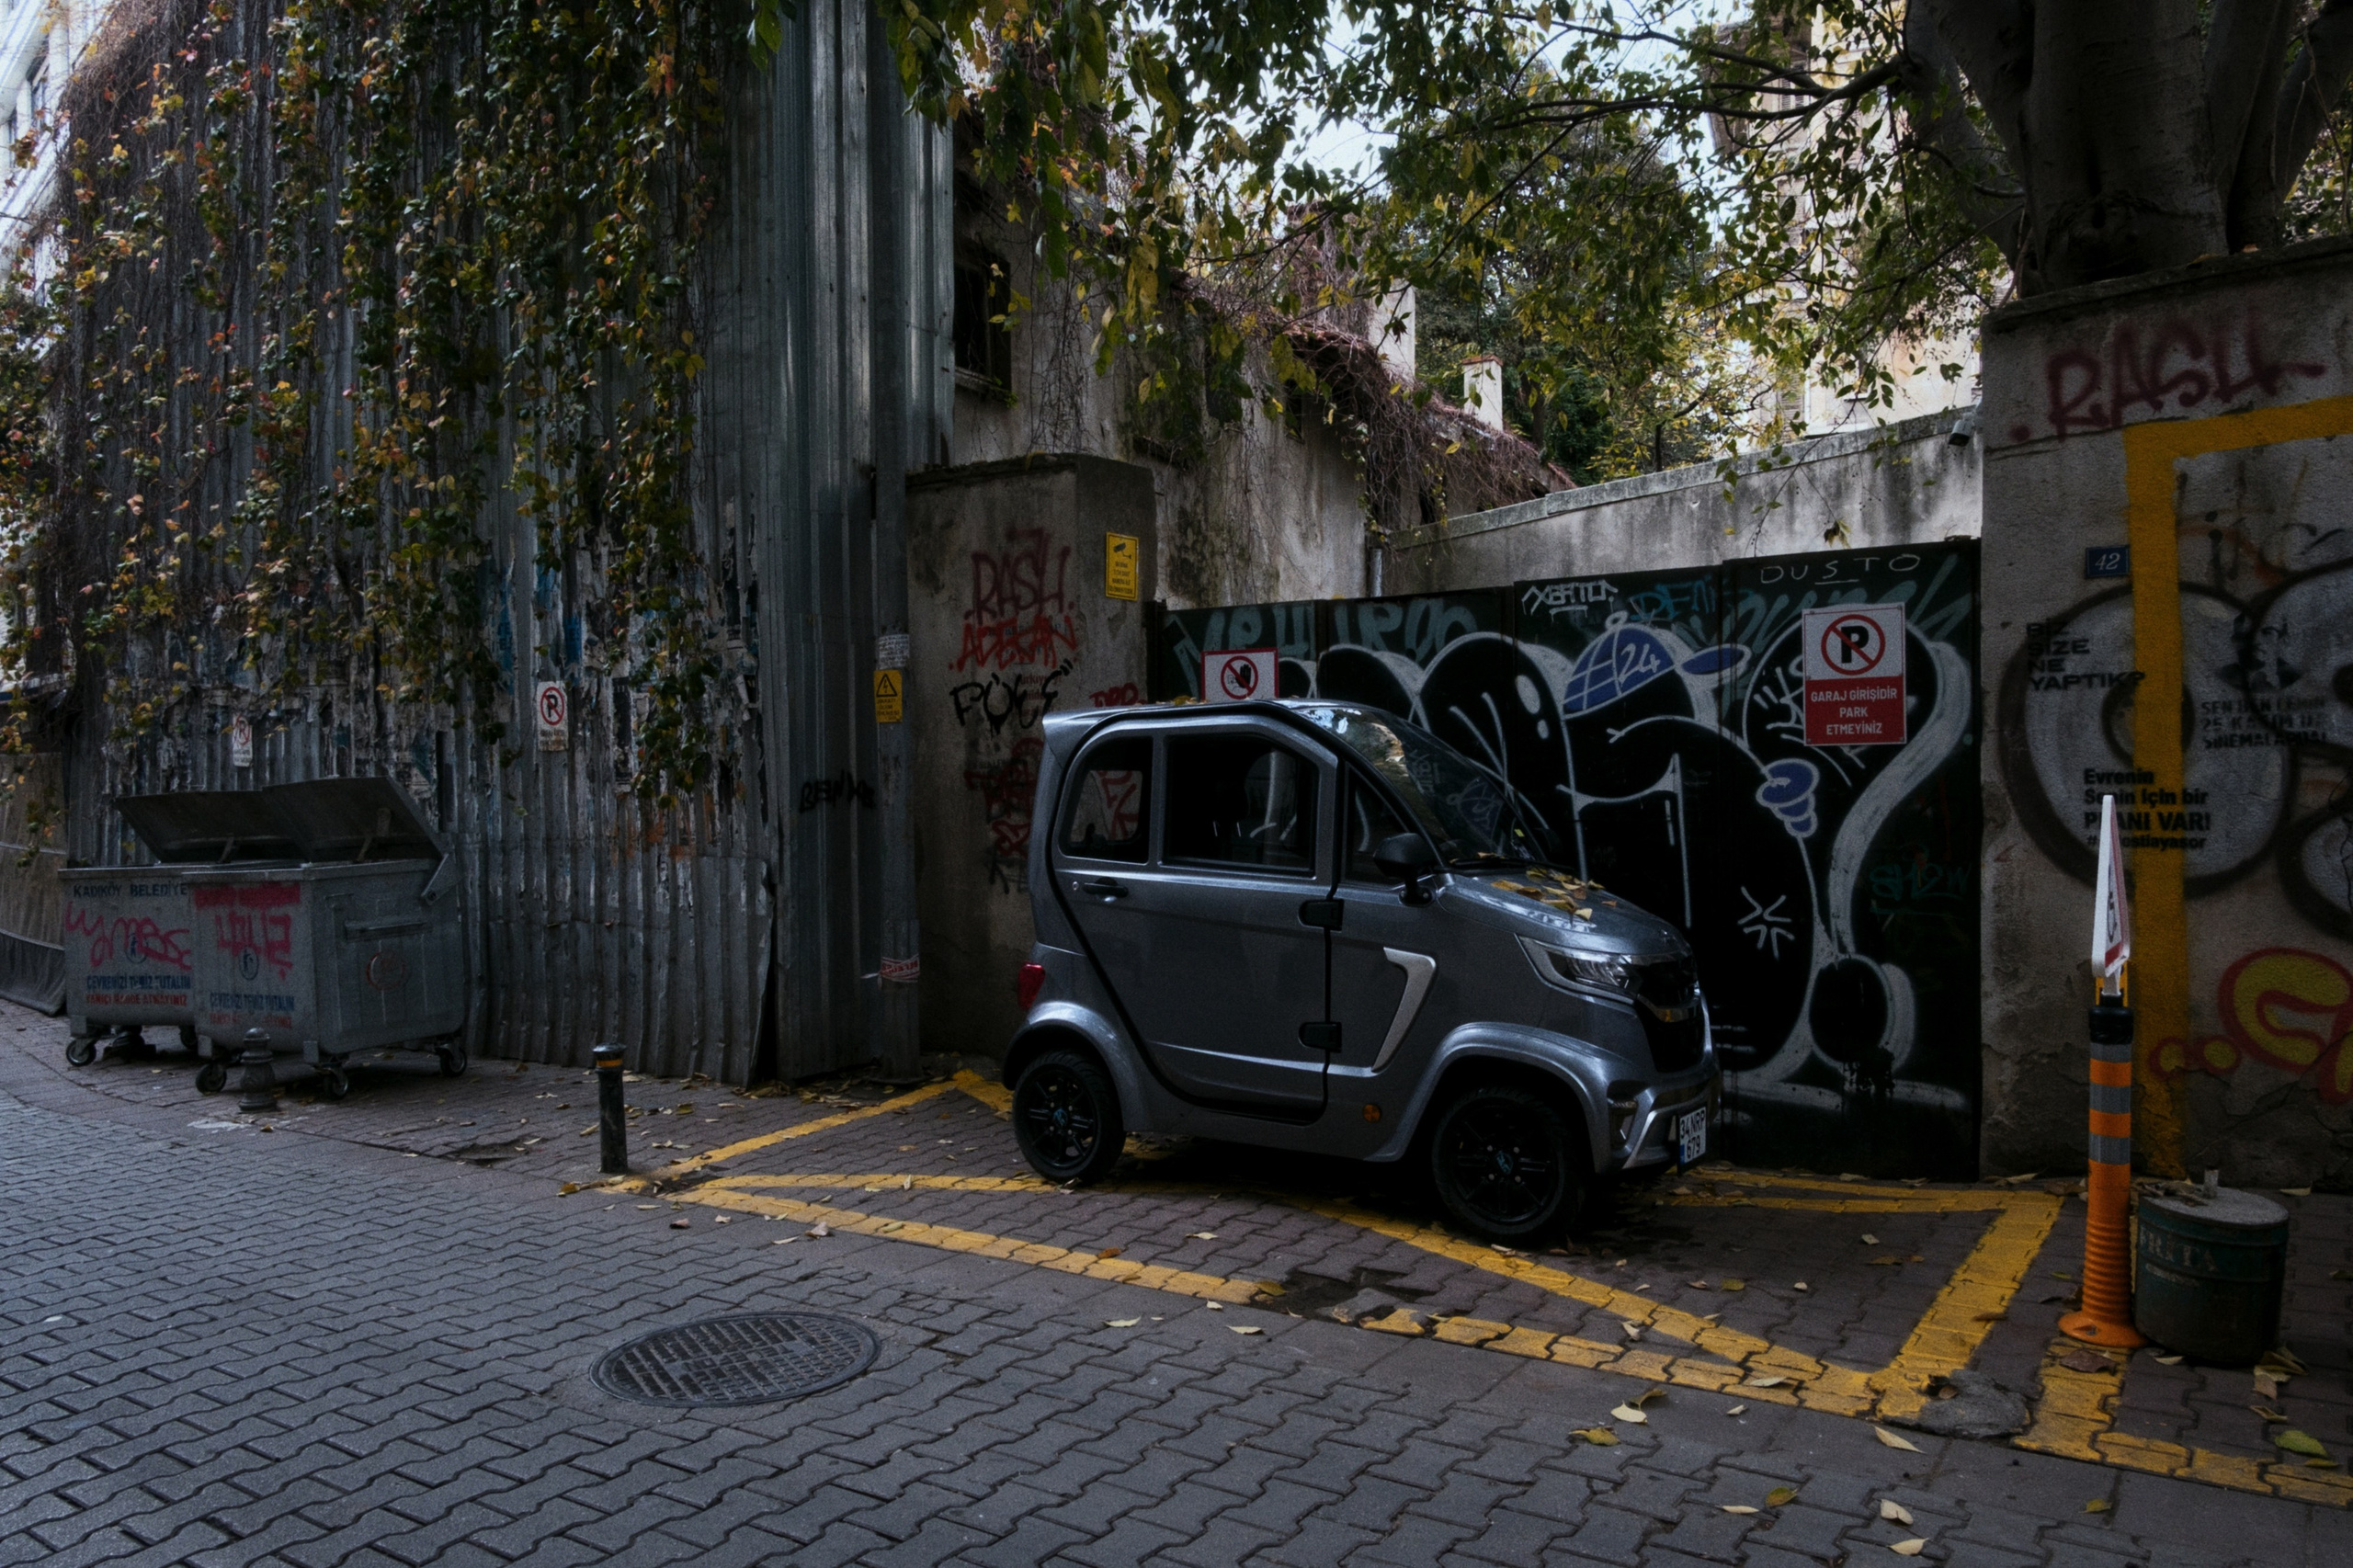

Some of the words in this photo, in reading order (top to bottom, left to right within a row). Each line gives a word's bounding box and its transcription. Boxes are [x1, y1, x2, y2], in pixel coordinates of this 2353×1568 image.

[1760, 553, 1921, 585] DUSTO
[2095, 552, 2120, 571] 42
[1620, 642, 1661, 687] 24
[1811, 690, 1847, 702] GARAJ
[1849, 686, 1898, 702] GİRİŞİDİR
[1839, 706, 1869, 718] PARK
[1825, 721, 1882, 735] ETMEYİNİZ
[2084, 768, 2154, 785] Evrenin
[2182, 787, 2209, 804] bir
[2156, 811, 2211, 831] VAR!
[74, 881, 120, 898] KADIKÖY
[1687, 1134, 1700, 1159] 679
